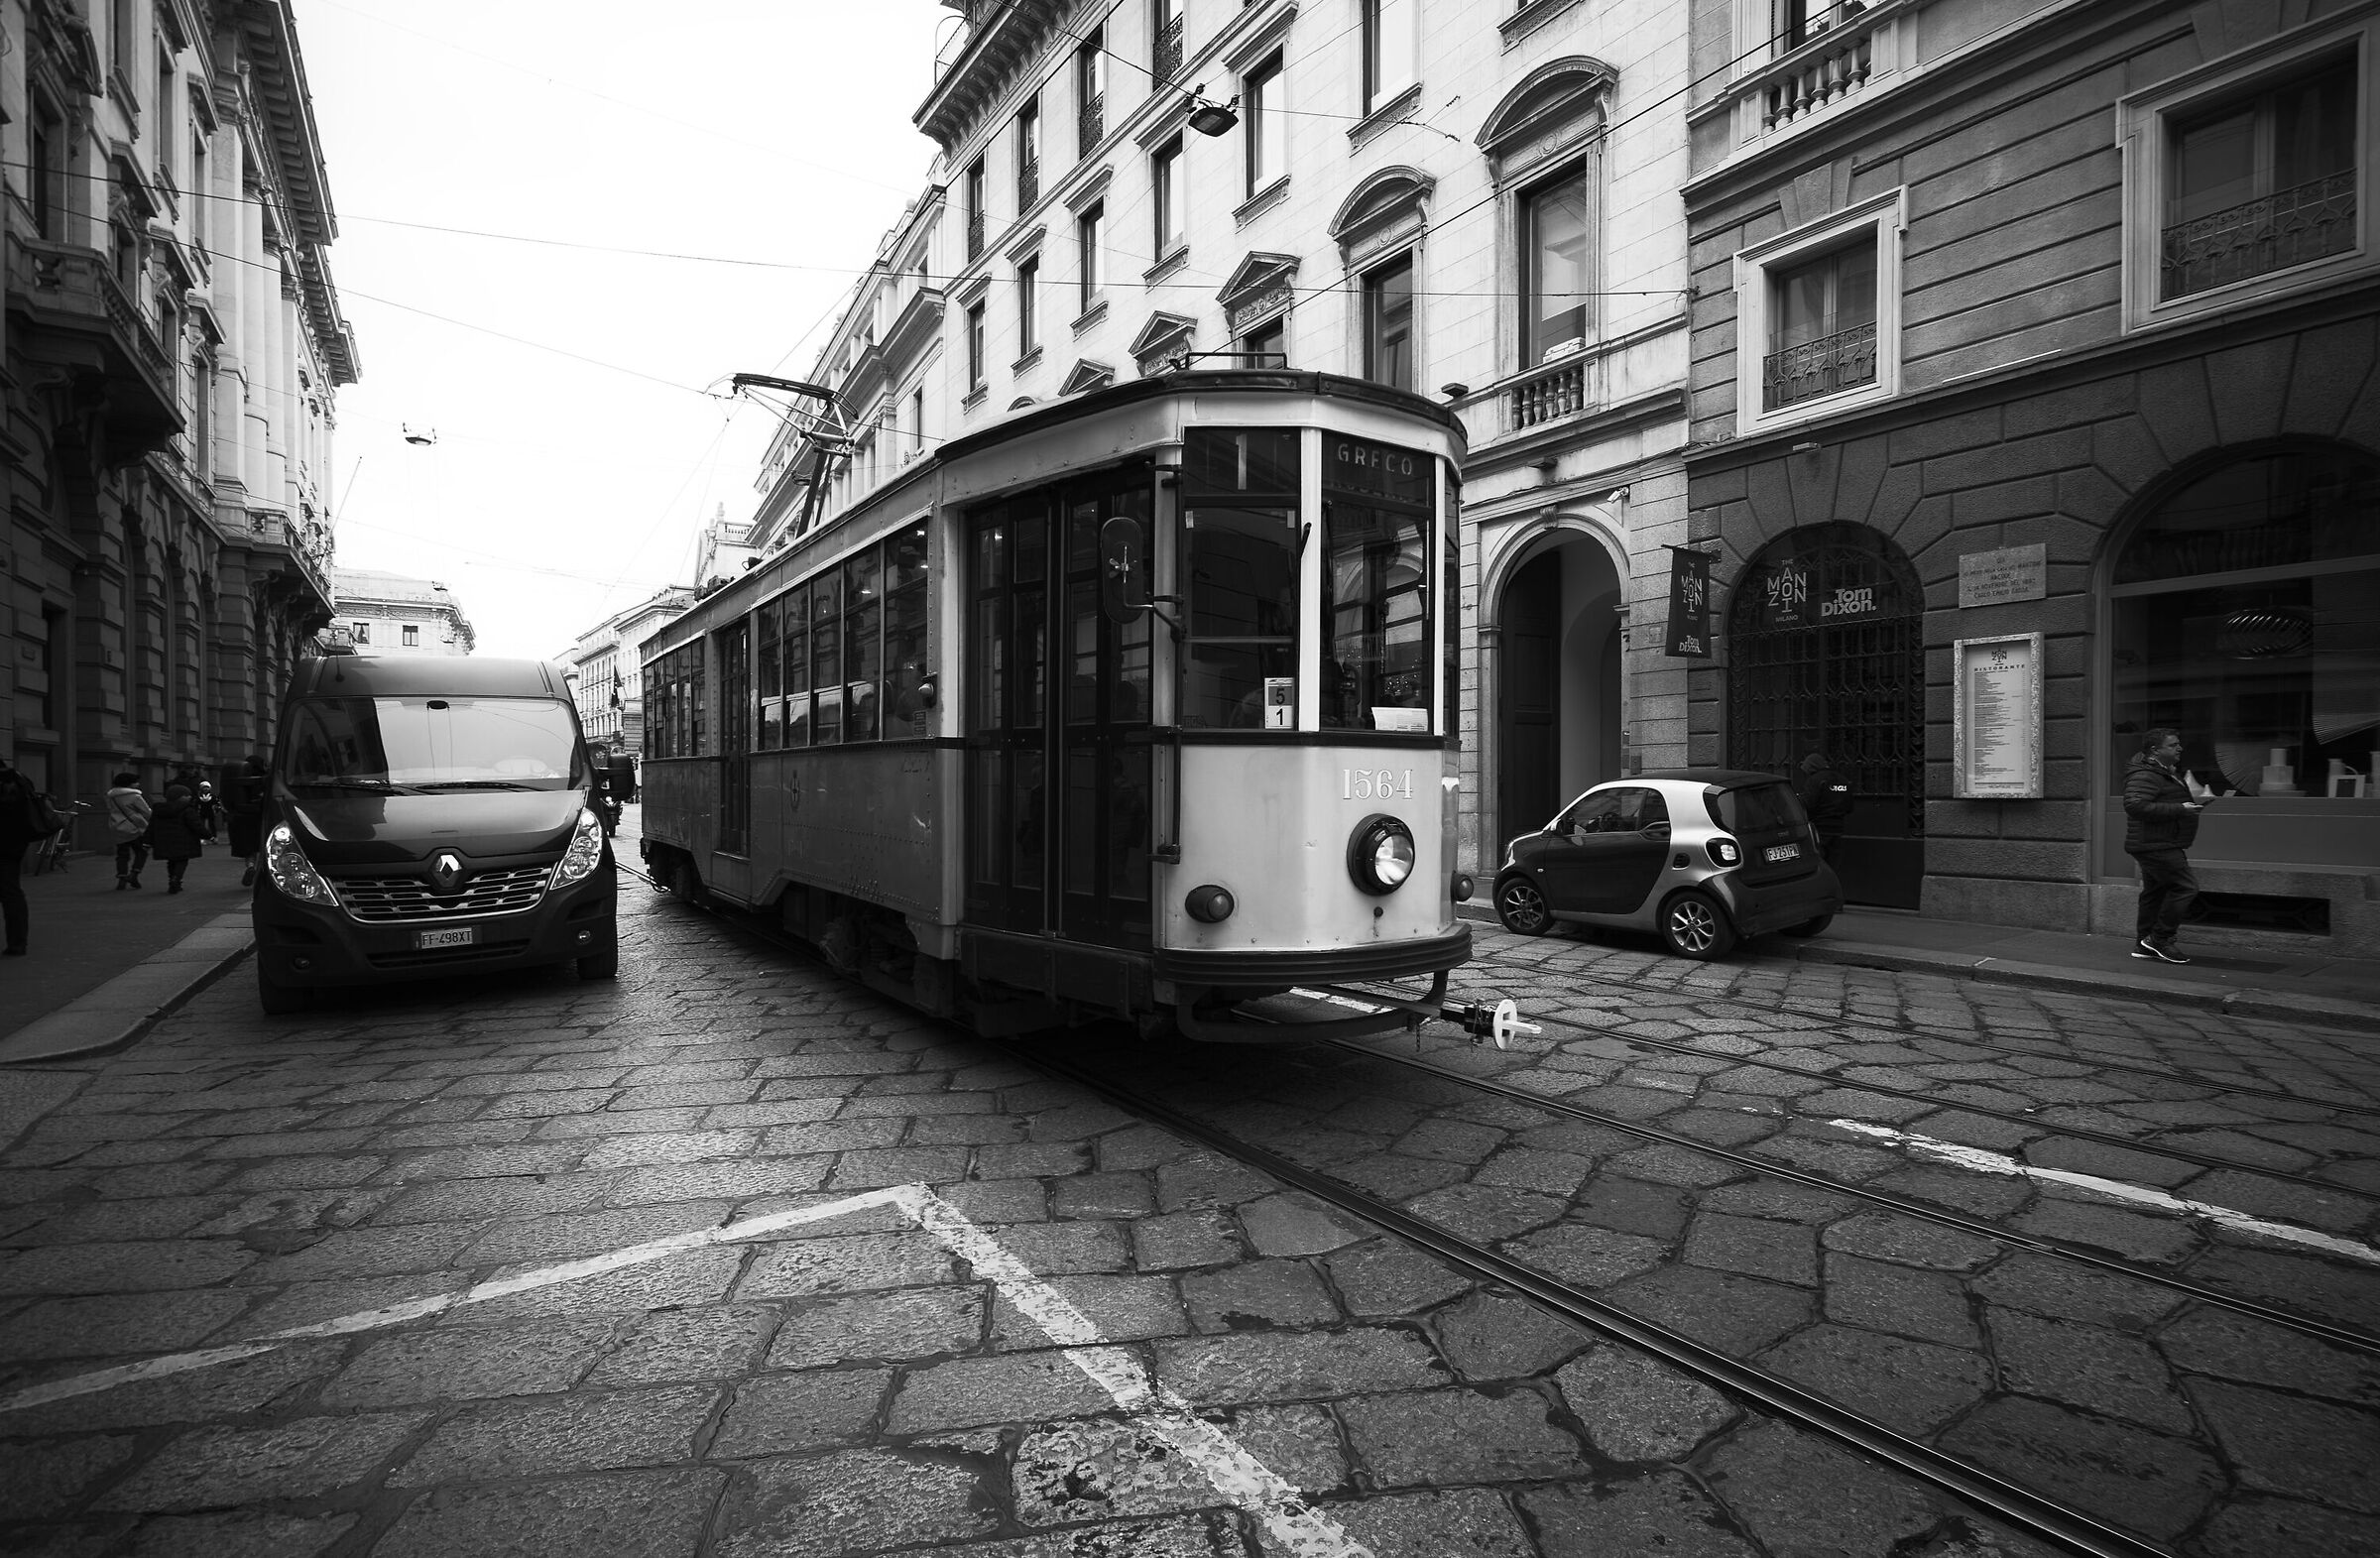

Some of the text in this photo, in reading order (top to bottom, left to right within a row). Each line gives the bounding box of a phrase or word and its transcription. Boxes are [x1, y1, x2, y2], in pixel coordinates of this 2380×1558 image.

[1835, 587, 1873, 603] Tom
[1775, 614, 1799, 623] MILANO
[1276, 687, 1285, 705] 5
[1276, 707, 1283, 726] 1
[1342, 769, 1413, 800] 1564
